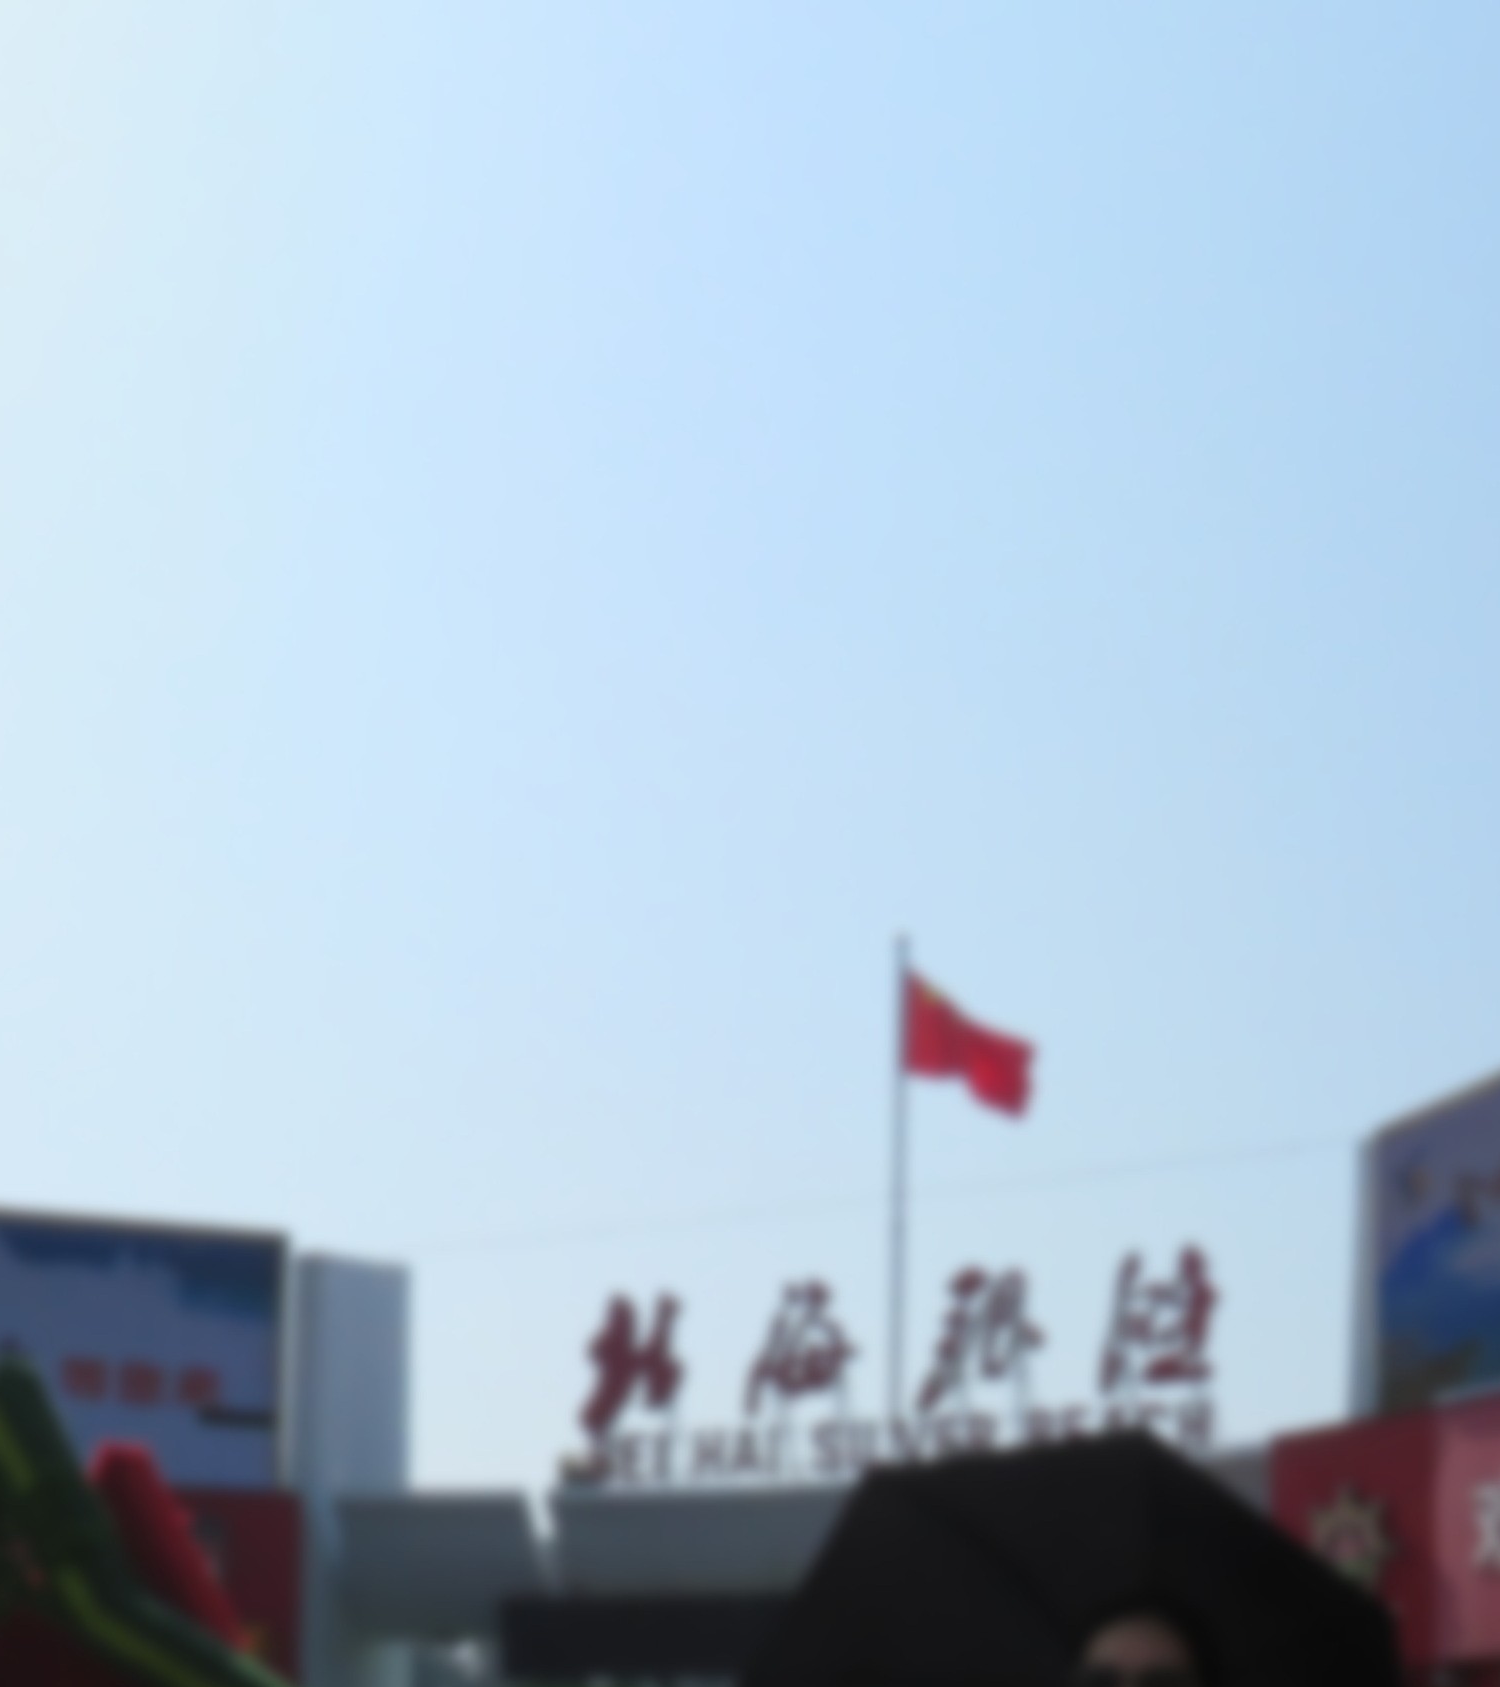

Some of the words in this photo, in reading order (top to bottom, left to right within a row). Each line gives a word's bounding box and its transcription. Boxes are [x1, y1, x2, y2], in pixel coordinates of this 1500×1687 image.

[580, 1242, 1218, 1436] 北海银滩
[693, 1424, 780, 1475] HAI
